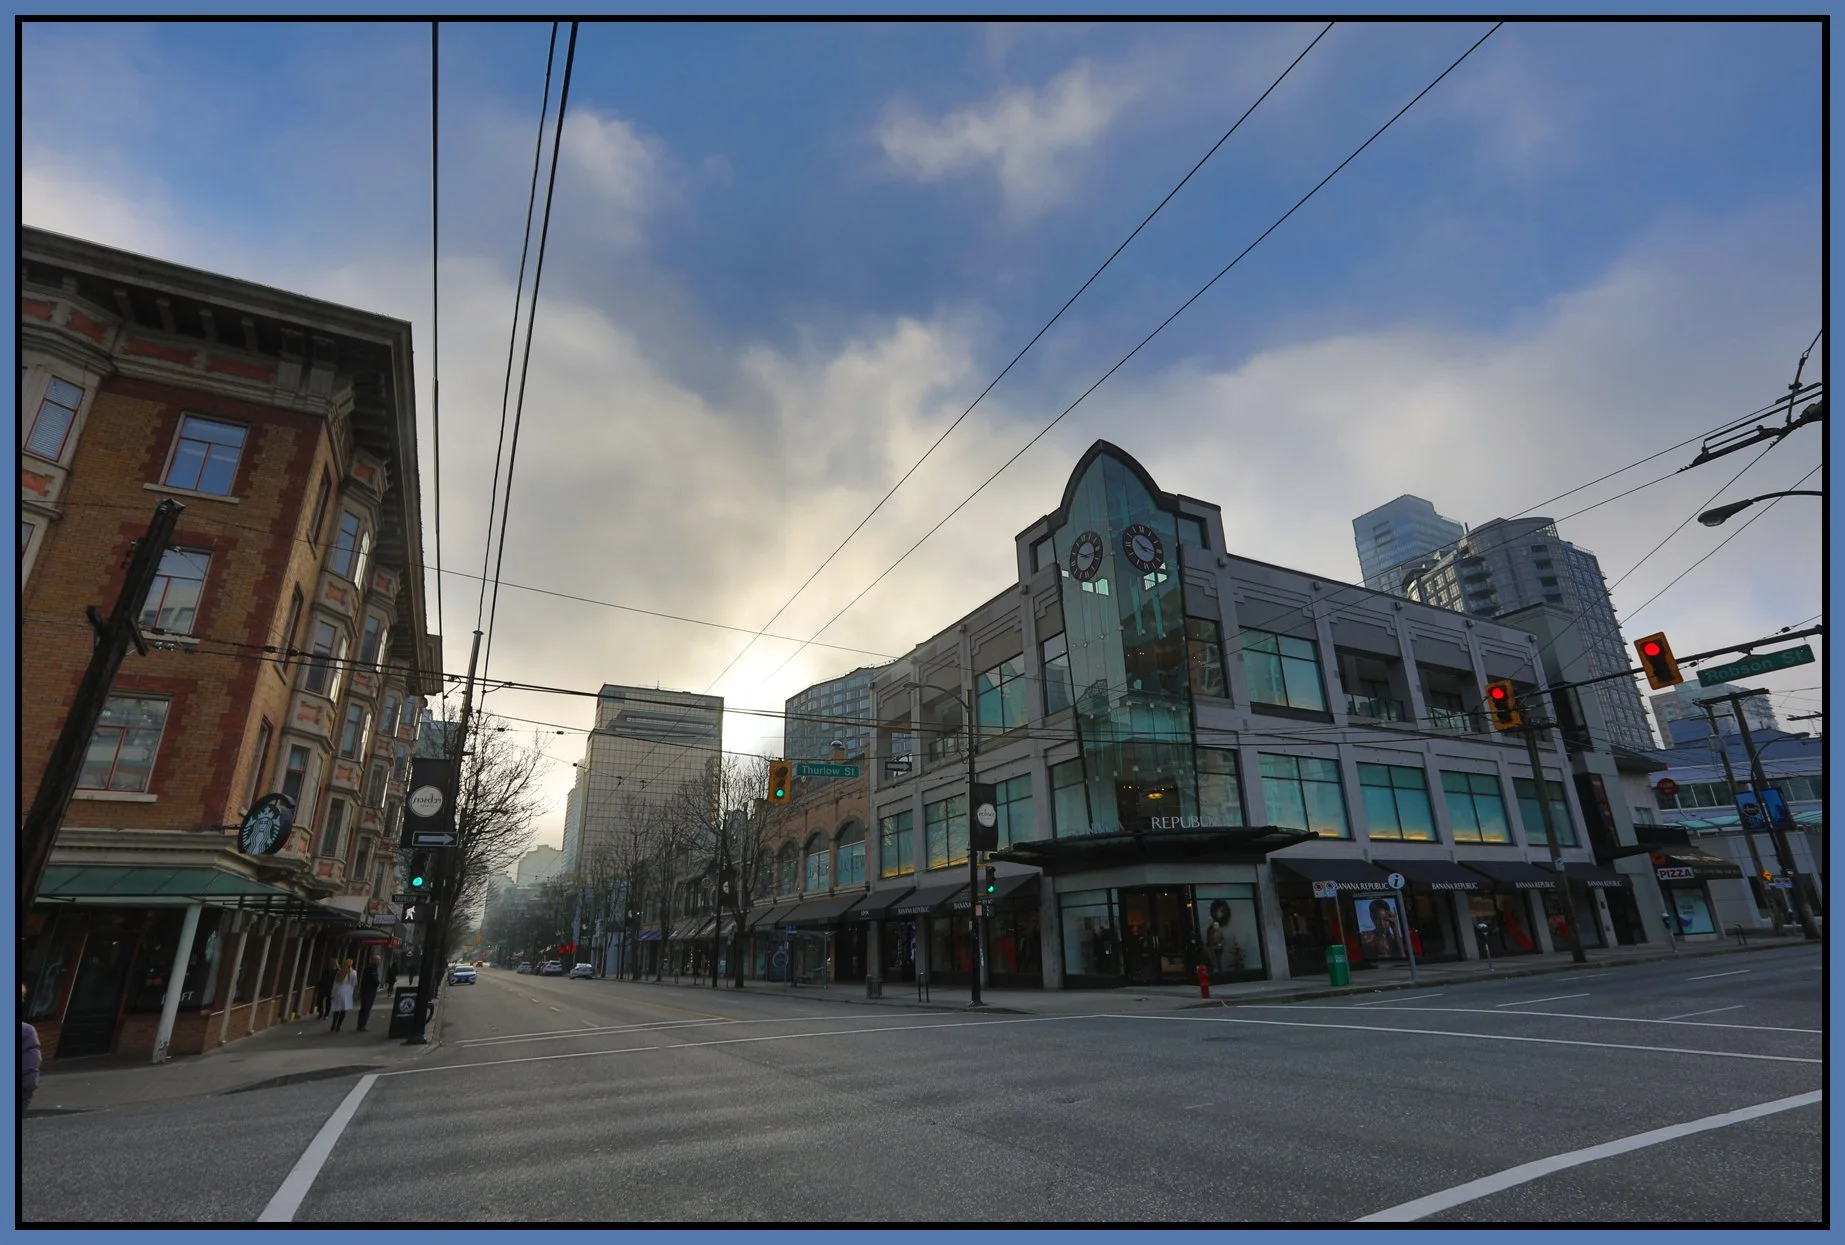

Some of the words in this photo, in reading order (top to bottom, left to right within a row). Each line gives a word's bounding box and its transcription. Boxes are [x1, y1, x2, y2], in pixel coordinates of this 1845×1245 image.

[1705, 659, 1773, 681] Robson
[1781, 649, 1805, 664] St
[801, 765, 840, 775] Thurlow
[844, 767, 855, 776] St
[1659, 868, 1692, 879] PIZZA
[1335, 882, 1360, 890] BANANA
[1431, 882, 1454, 890] BANANA
[1454, 882, 1479, 890] REPUBLIC
